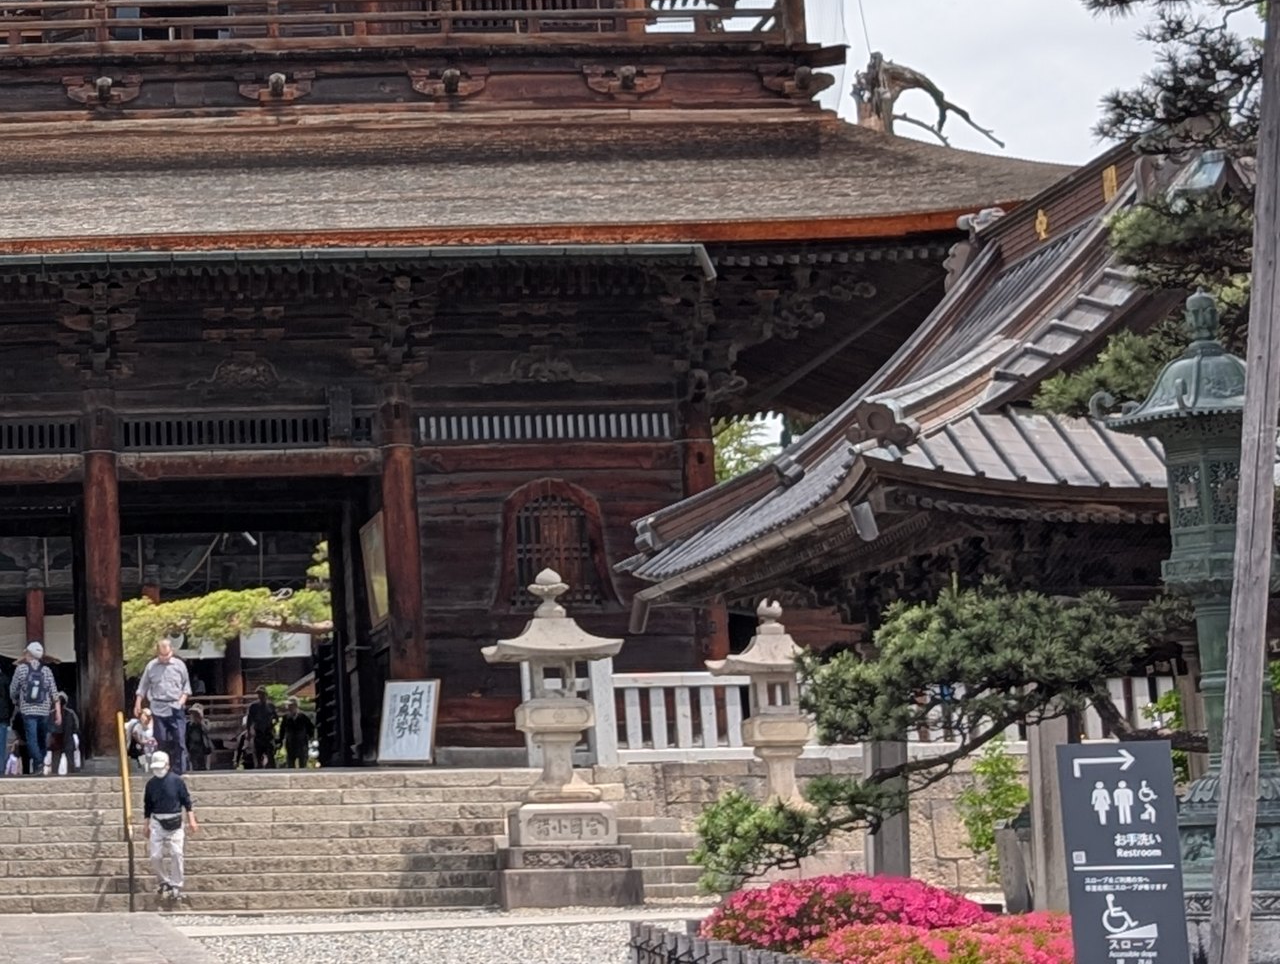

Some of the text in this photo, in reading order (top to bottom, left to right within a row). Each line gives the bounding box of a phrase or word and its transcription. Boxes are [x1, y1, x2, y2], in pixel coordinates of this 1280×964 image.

[1114, 832, 1162, 846] お手洗い
[1116, 848, 1162, 858] Restroom
[1109, 939, 1156, 950] スロープ
